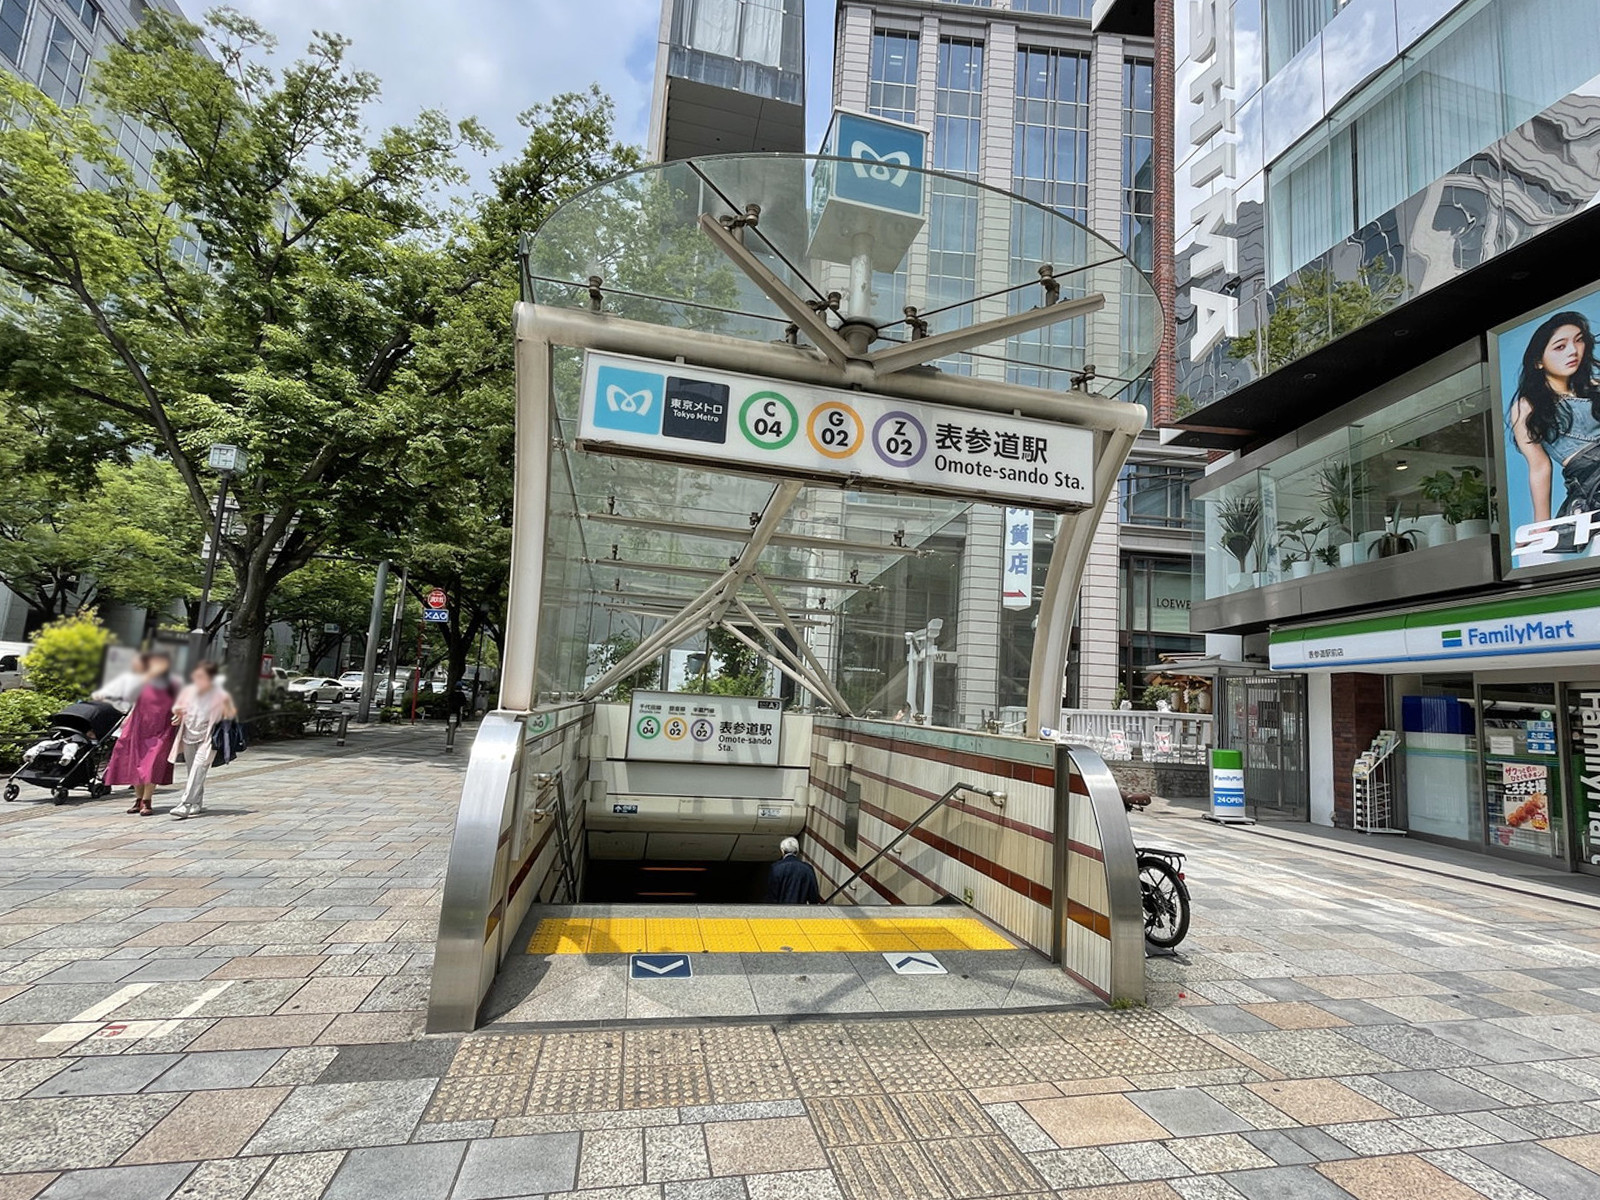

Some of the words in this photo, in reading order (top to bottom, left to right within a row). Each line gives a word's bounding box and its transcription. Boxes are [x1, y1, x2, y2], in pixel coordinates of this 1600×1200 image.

[670, 398, 723, 415] 東京メトロ
[763, 401, 776, 417] C
[672, 409, 696, 420] Tokyo
[696, 412, 719, 423] Metro
[828, 411, 844, 427] G
[754, 418, 783, 437] 04
[894, 421, 907, 436] Z
[821, 428, 849, 447] 02
[935, 423, 1048, 464] 表参道駅
[886, 437, 913, 456] 02
[935, 455, 1049, 486] Omote-sando
[1055, 471, 1085, 490] Sta.
[1156, 597, 1192, 610] LOEWE
[1468, 620, 1575, 645] FamilyMart
[669, 728, 681, 736] 02
[720, 721, 772, 736] 表参道駅
[718, 735, 772, 745] Omote-sando
[718, 743, 733, 752] Sta.
